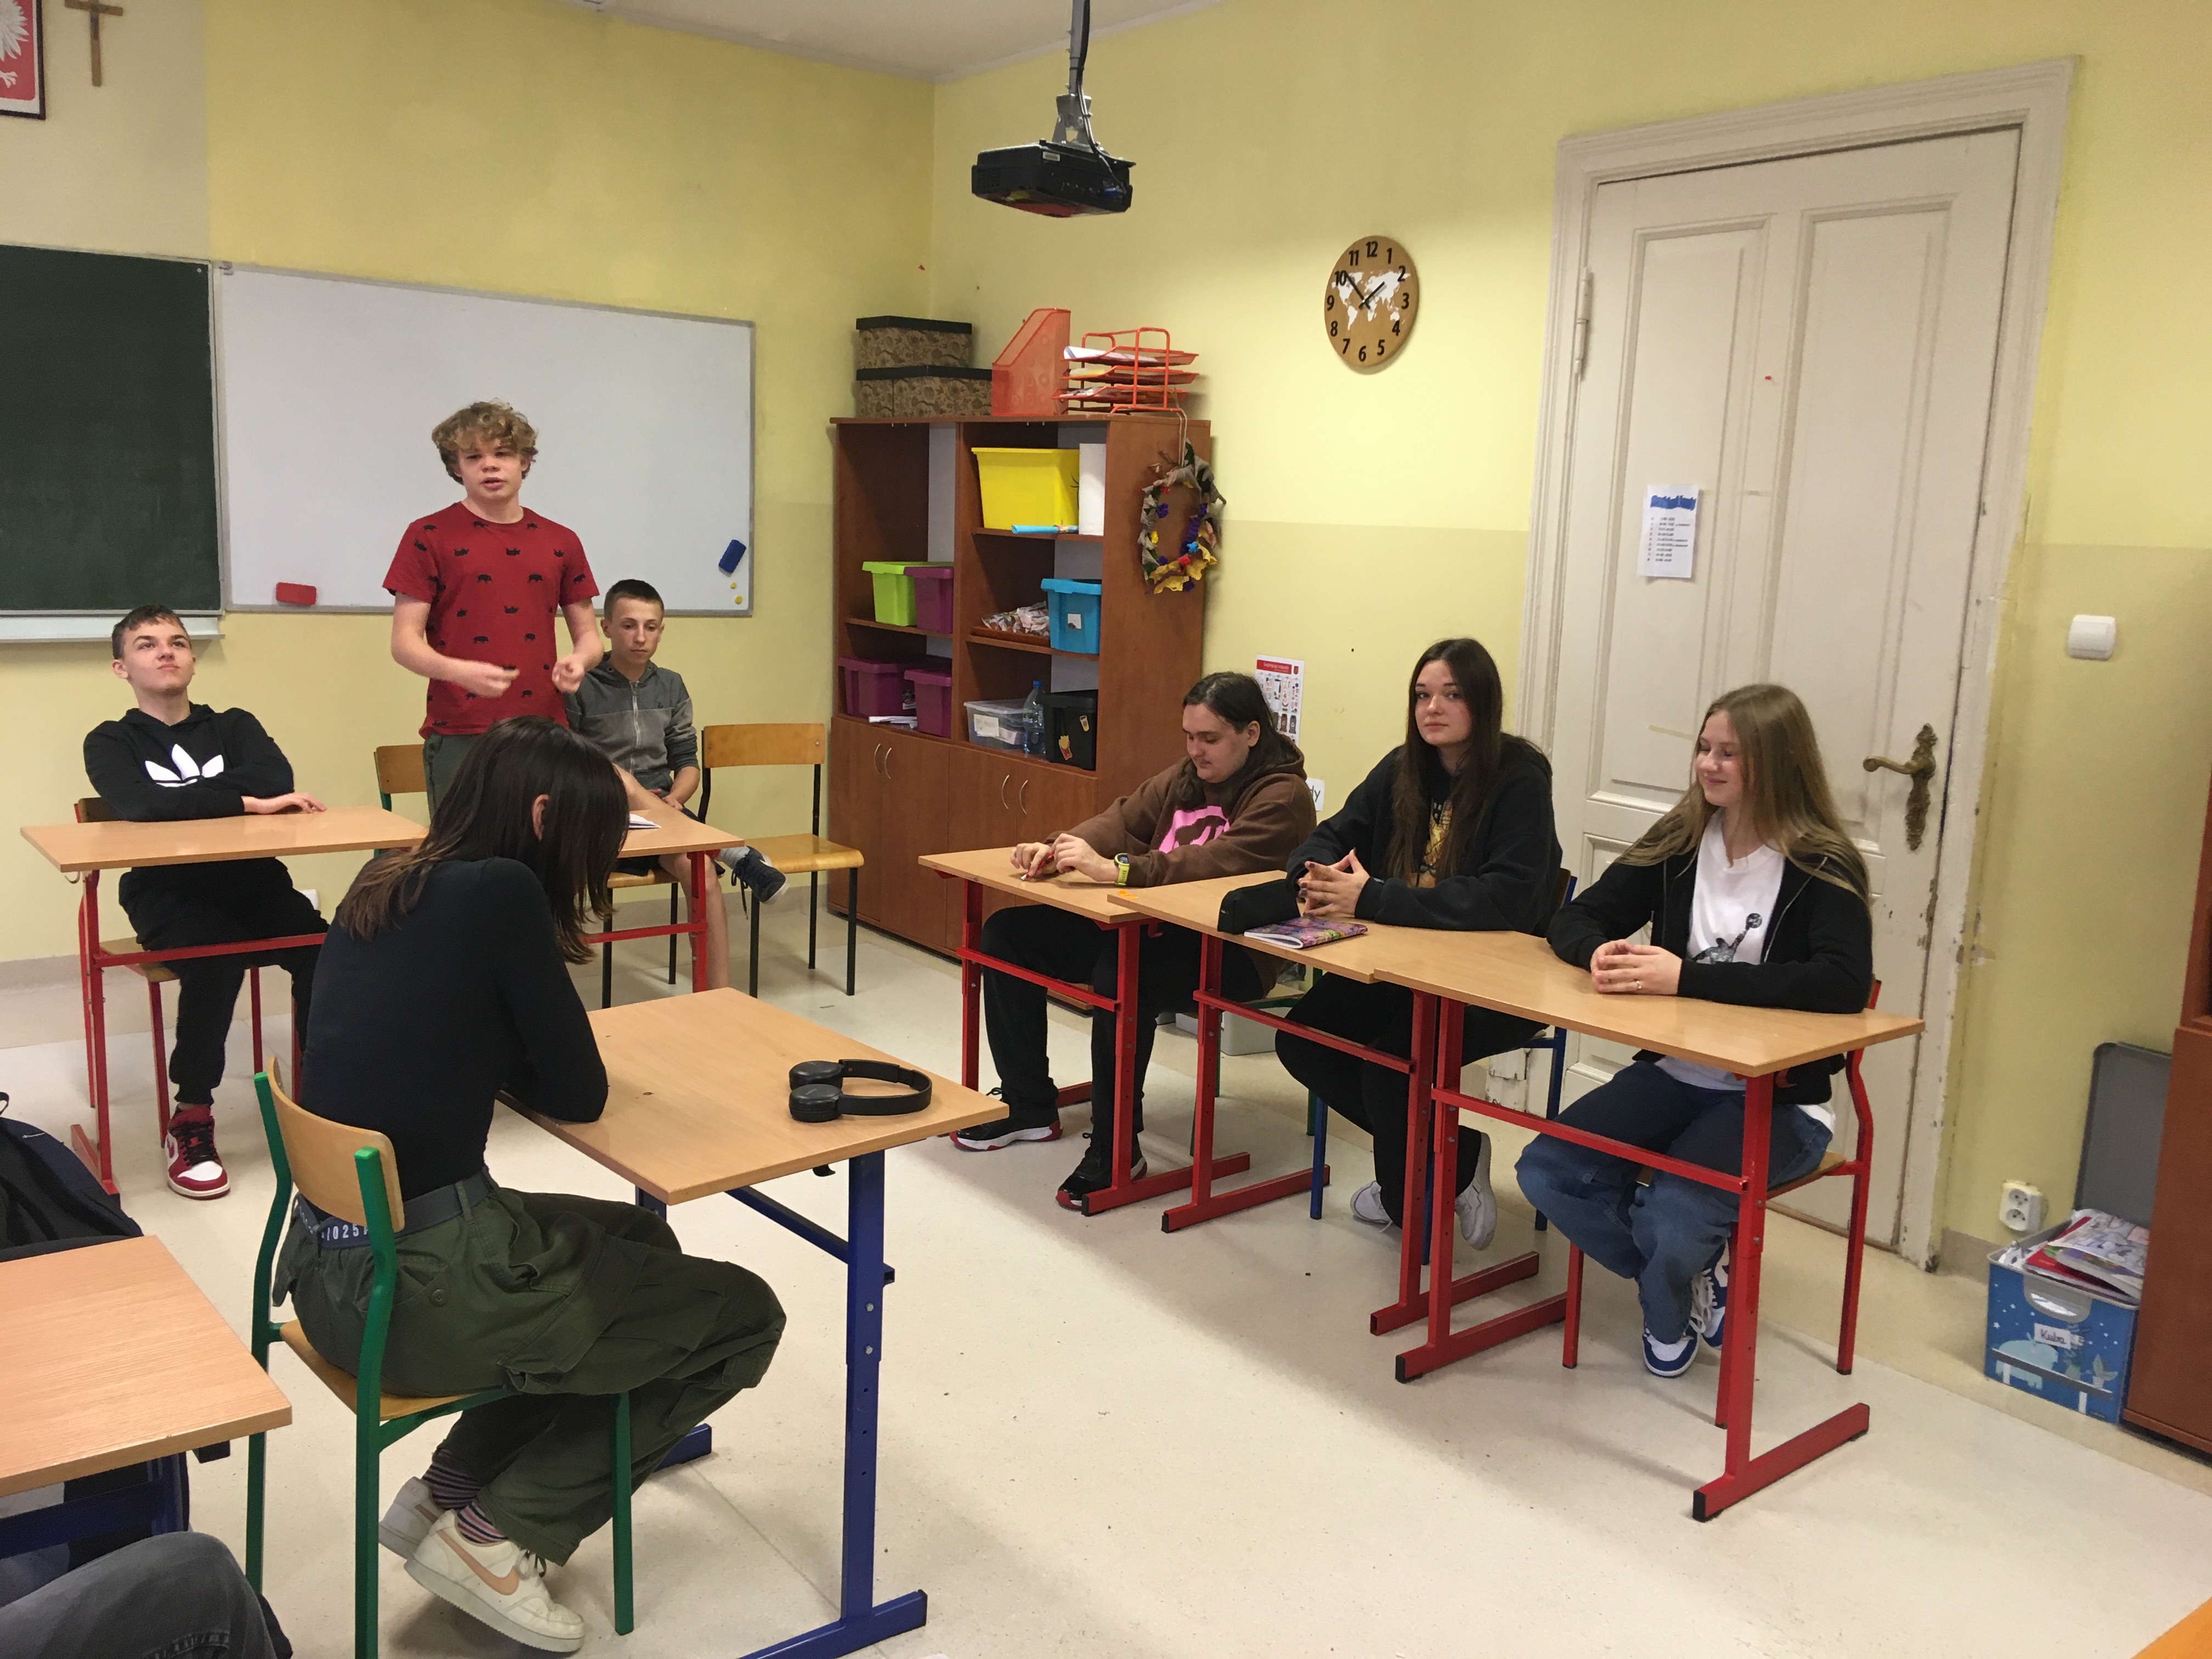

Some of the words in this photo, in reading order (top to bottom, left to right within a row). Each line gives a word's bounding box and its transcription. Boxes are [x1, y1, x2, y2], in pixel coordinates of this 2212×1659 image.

[1366, 240, 1378, 258] 12
[1386, 247, 1392, 264] 1
[1348, 250, 1359, 266] 11
[1334, 270, 1347, 286] 10
[1397, 266, 1406, 282] 2
[1327, 295, 1335, 311] 9
[1401, 292, 1409, 309] 3
[1330, 320, 1338, 337] 8
[1392, 320, 1400, 336] 4
[1342, 338, 1350, 354] 7
[1358, 346, 1366, 362] 6
[1377, 340, 1385, 356] 5
[2040, 1329, 2067, 1345] Kuba
